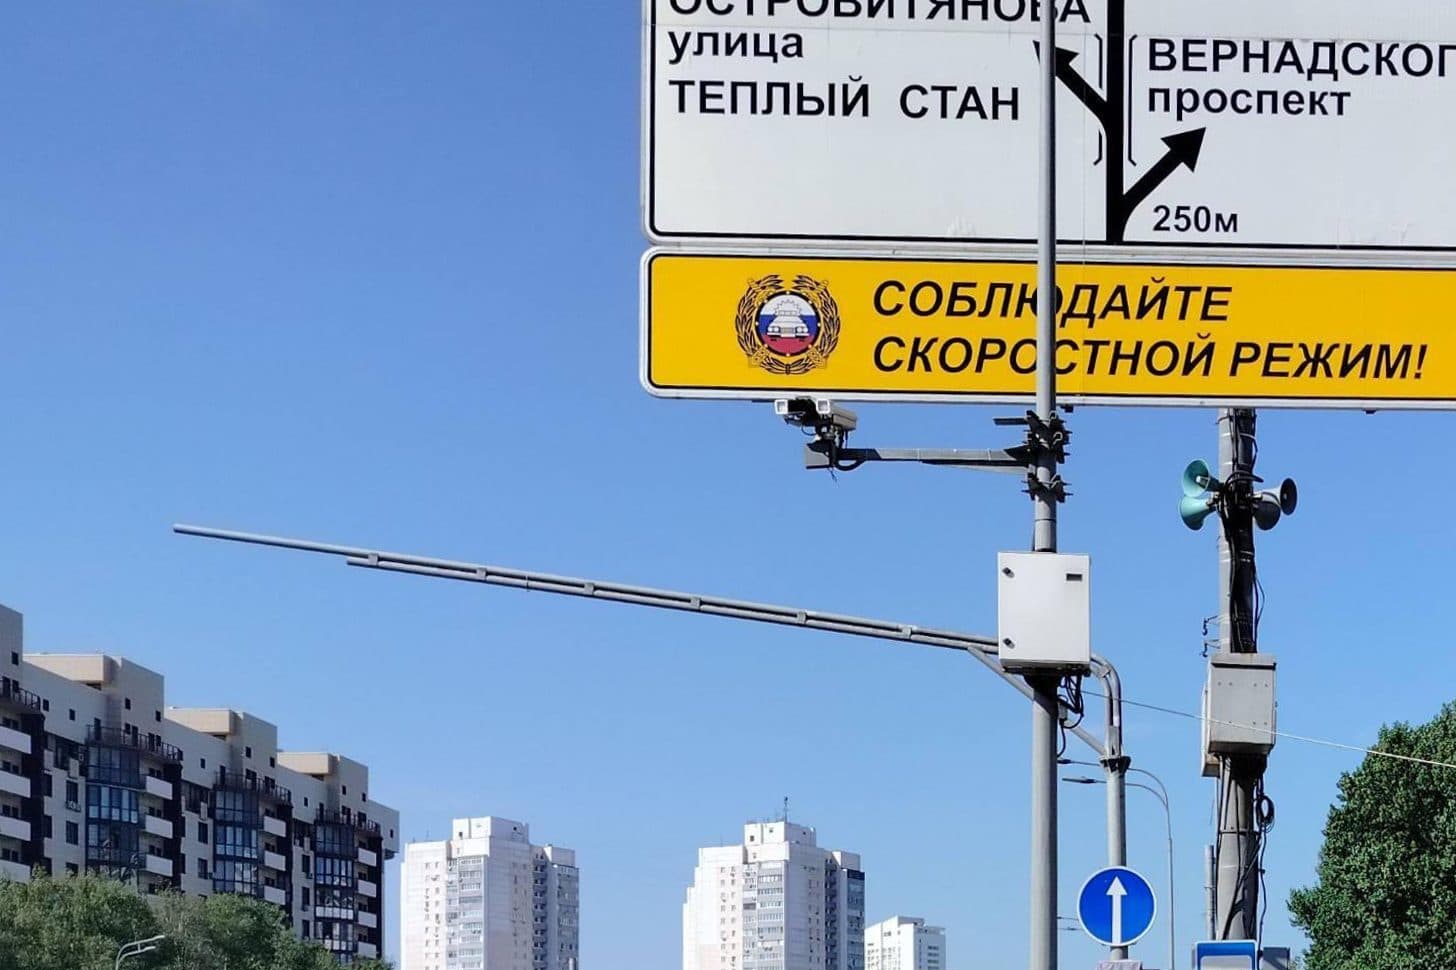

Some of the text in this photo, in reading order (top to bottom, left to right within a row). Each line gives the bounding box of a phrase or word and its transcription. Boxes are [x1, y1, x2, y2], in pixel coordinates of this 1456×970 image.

[668, 31, 803, 64] улица
[669, 75, 1019, 120] ТЕПЛЫЙ СТАН
[1148, 87, 1351, 121] проспект
[1153, 205, 1239, 233] 250м
[872, 277, 1233, 328] СОБЛЮДАЙТЕ
[872, 333, 1428, 380] СКОРОСТНОЙ РЕЖИМ!
